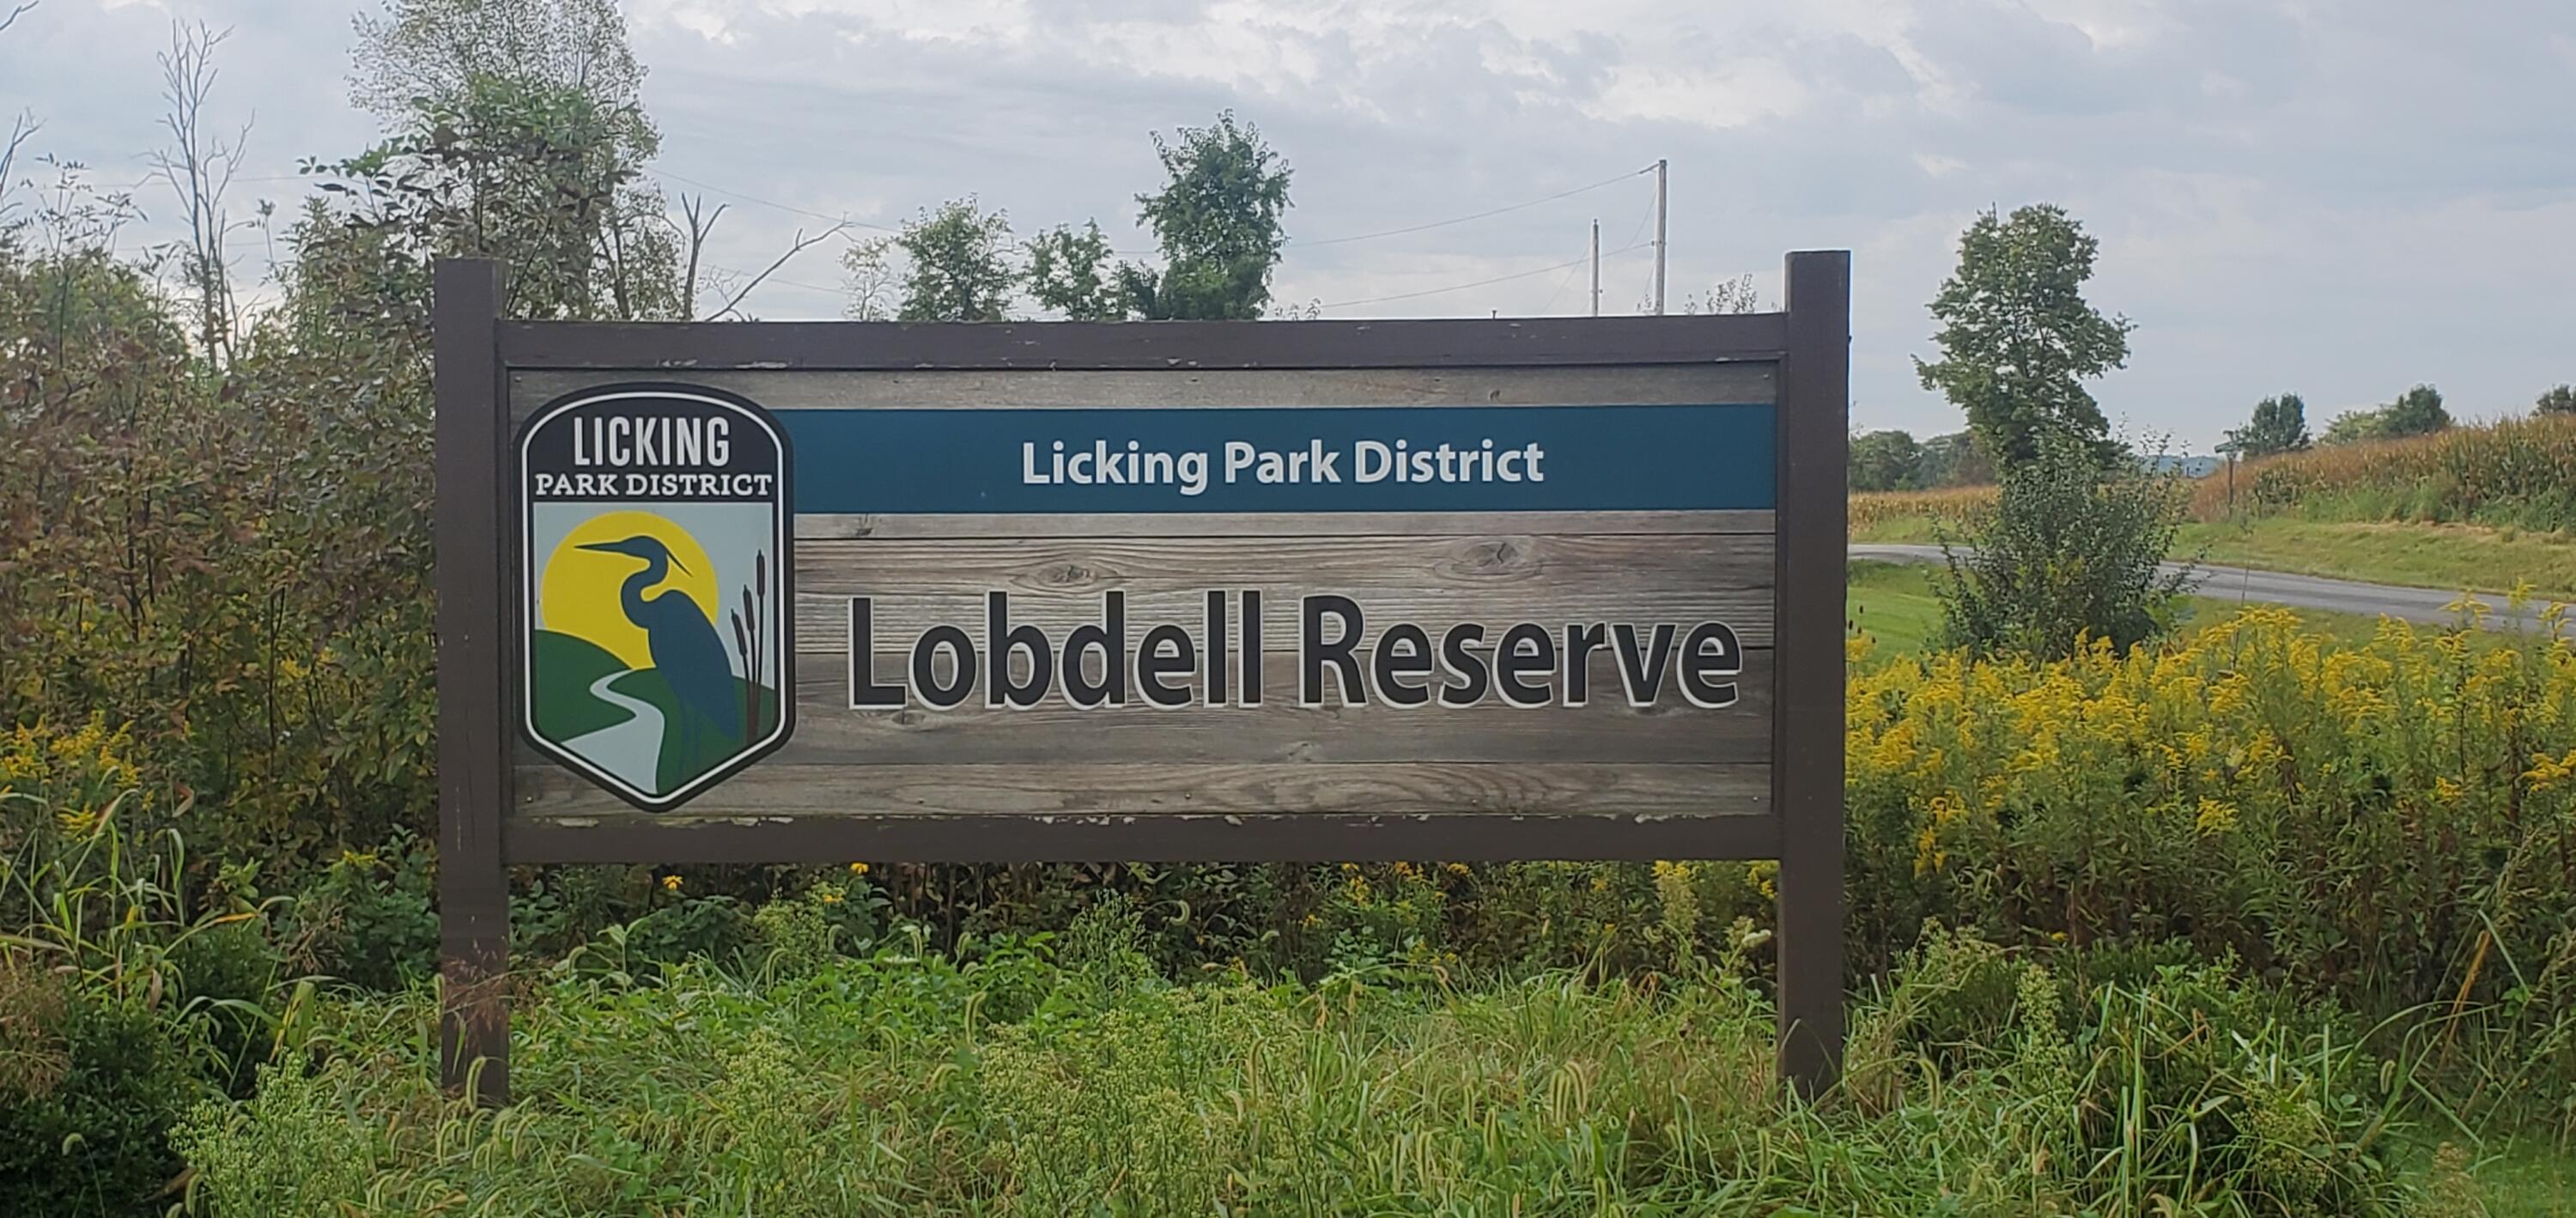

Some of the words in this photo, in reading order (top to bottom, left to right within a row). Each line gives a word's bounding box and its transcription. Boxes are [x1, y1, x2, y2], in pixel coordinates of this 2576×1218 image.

[574, 416, 730, 466] LICKING
[1023, 439, 1209, 496] Licking
[1224, 439, 1341, 484] Park
[1354, 439, 1545, 482] District
[534, 472, 620, 496] PARK
[624, 472, 773, 496] DISTRICT
[848, 590, 1262, 710] Lobdell
[1298, 594, 1742, 708] Reserve
